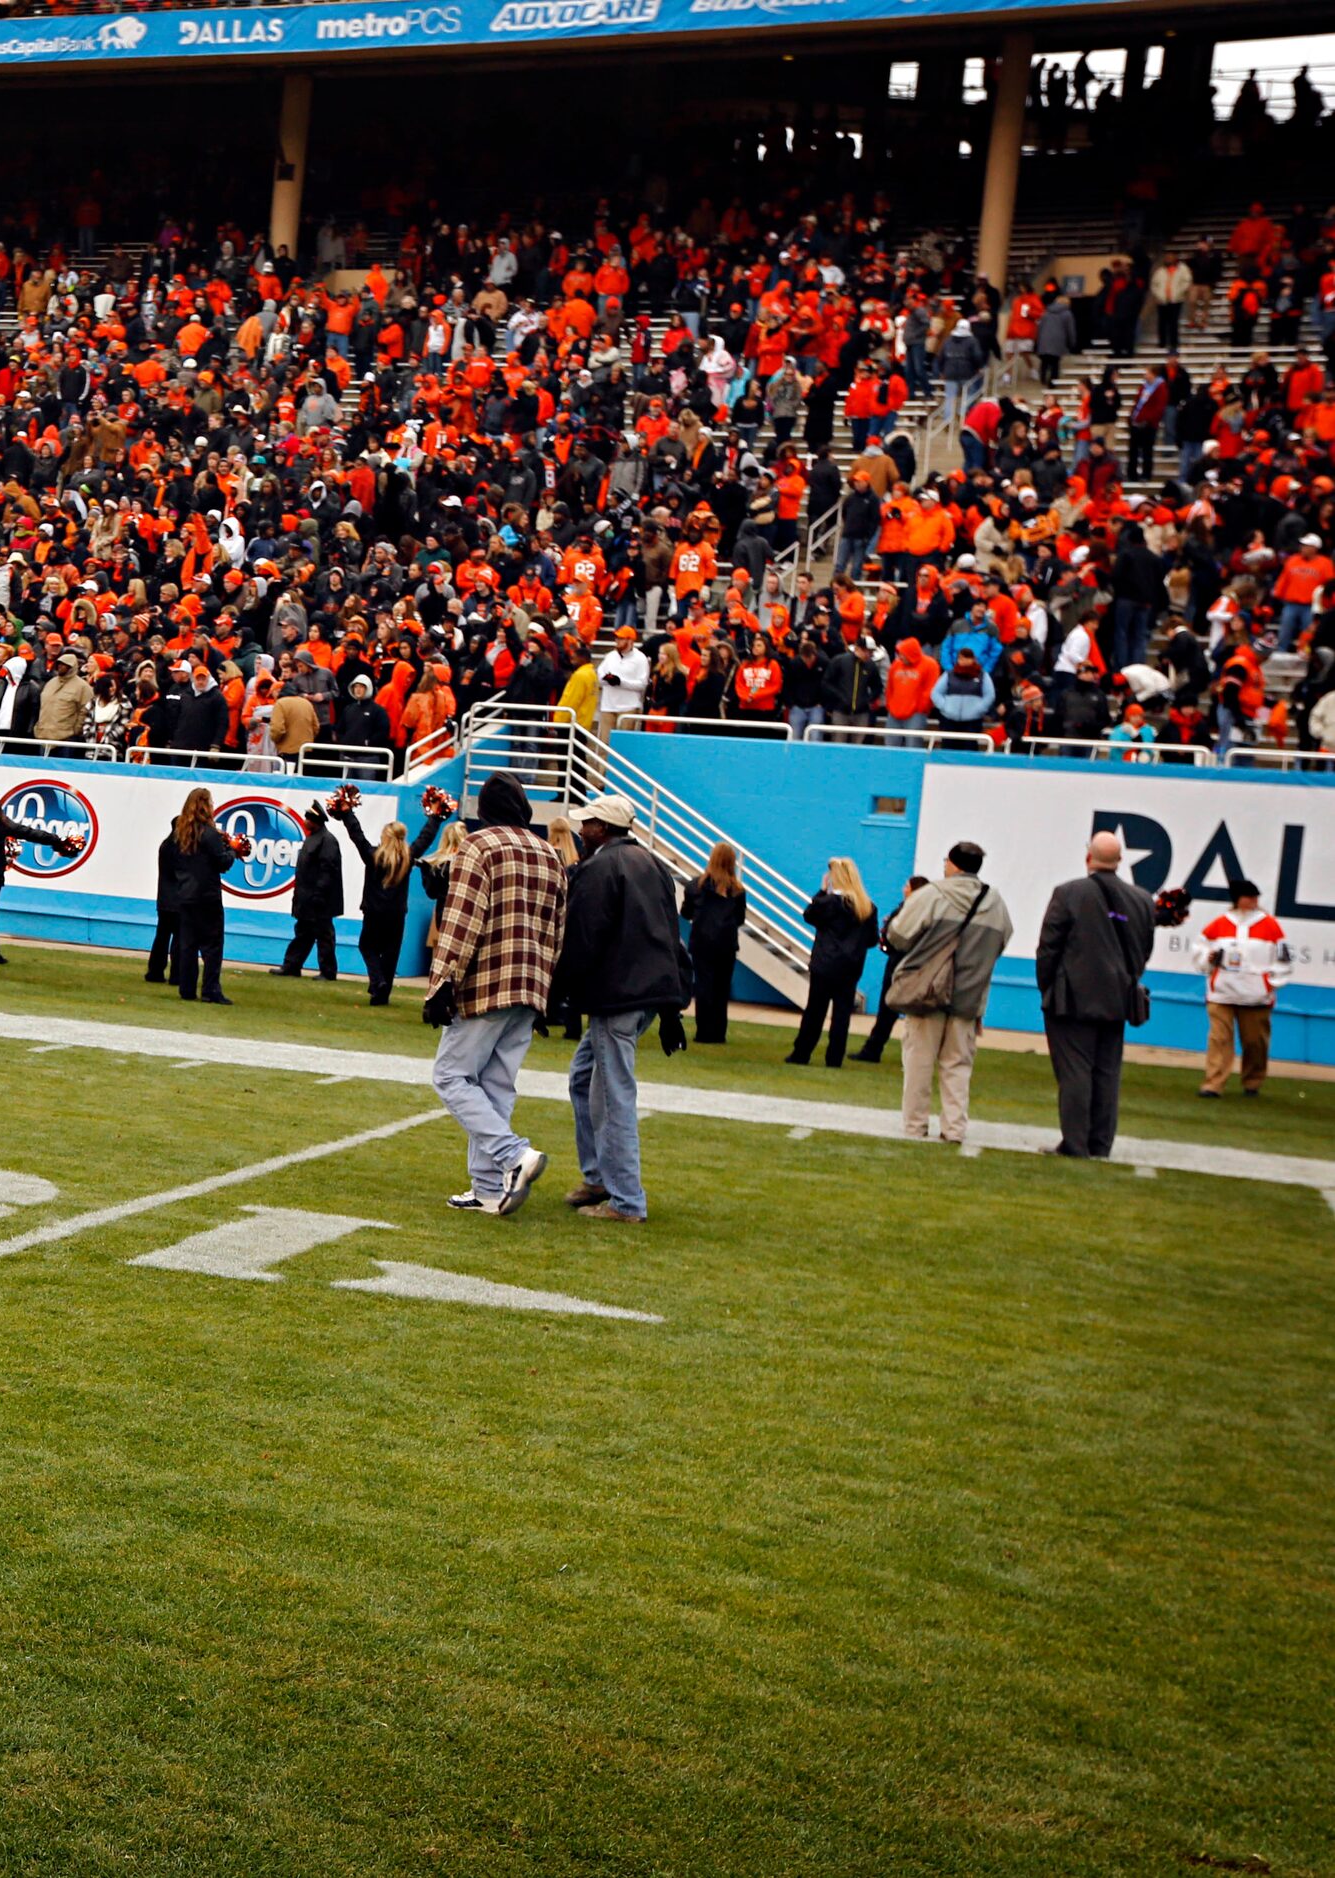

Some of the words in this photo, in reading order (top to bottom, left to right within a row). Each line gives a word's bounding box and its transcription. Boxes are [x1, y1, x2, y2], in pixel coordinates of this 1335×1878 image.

[316, 6, 462, 39] metroPCS
[489, 0, 663, 31] ADVOCARE
[178, 18, 284, 45] DALLAS
